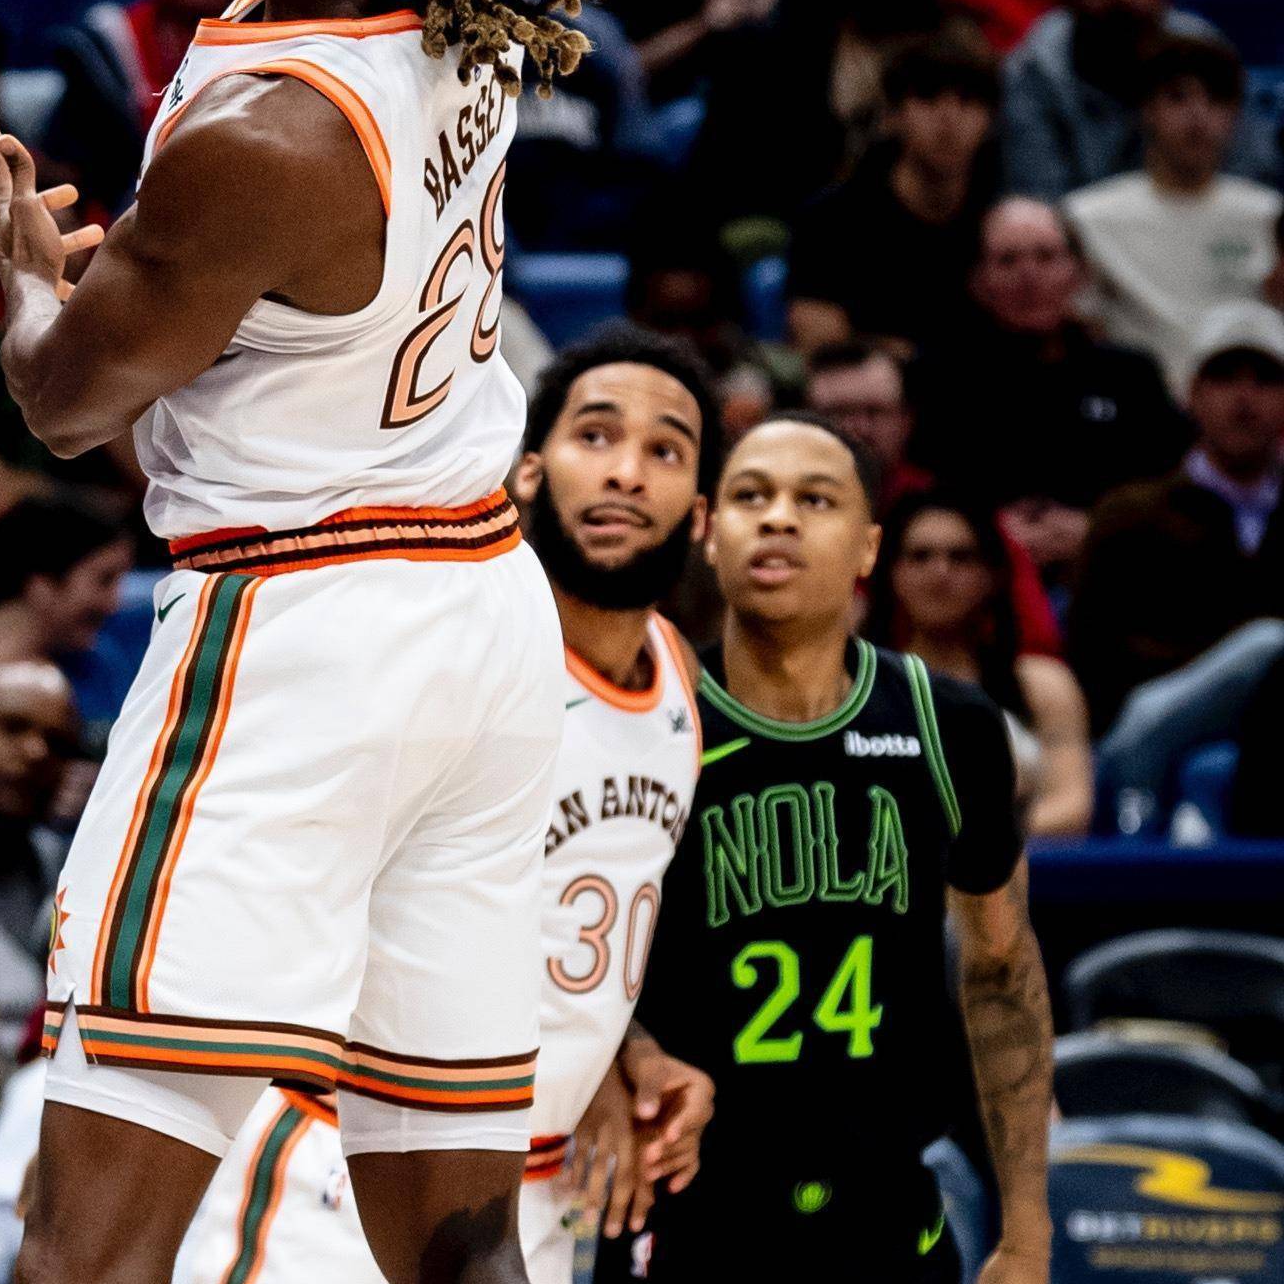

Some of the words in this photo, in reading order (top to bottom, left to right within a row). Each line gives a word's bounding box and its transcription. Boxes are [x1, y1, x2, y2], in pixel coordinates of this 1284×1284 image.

[423, 73, 505, 222] BASSE
[843, 729, 922, 758] ibotta
[701, 781, 909, 928] NOLA
[546, 873, 660, 1003] 30
[731, 934, 884, 1063] 24
